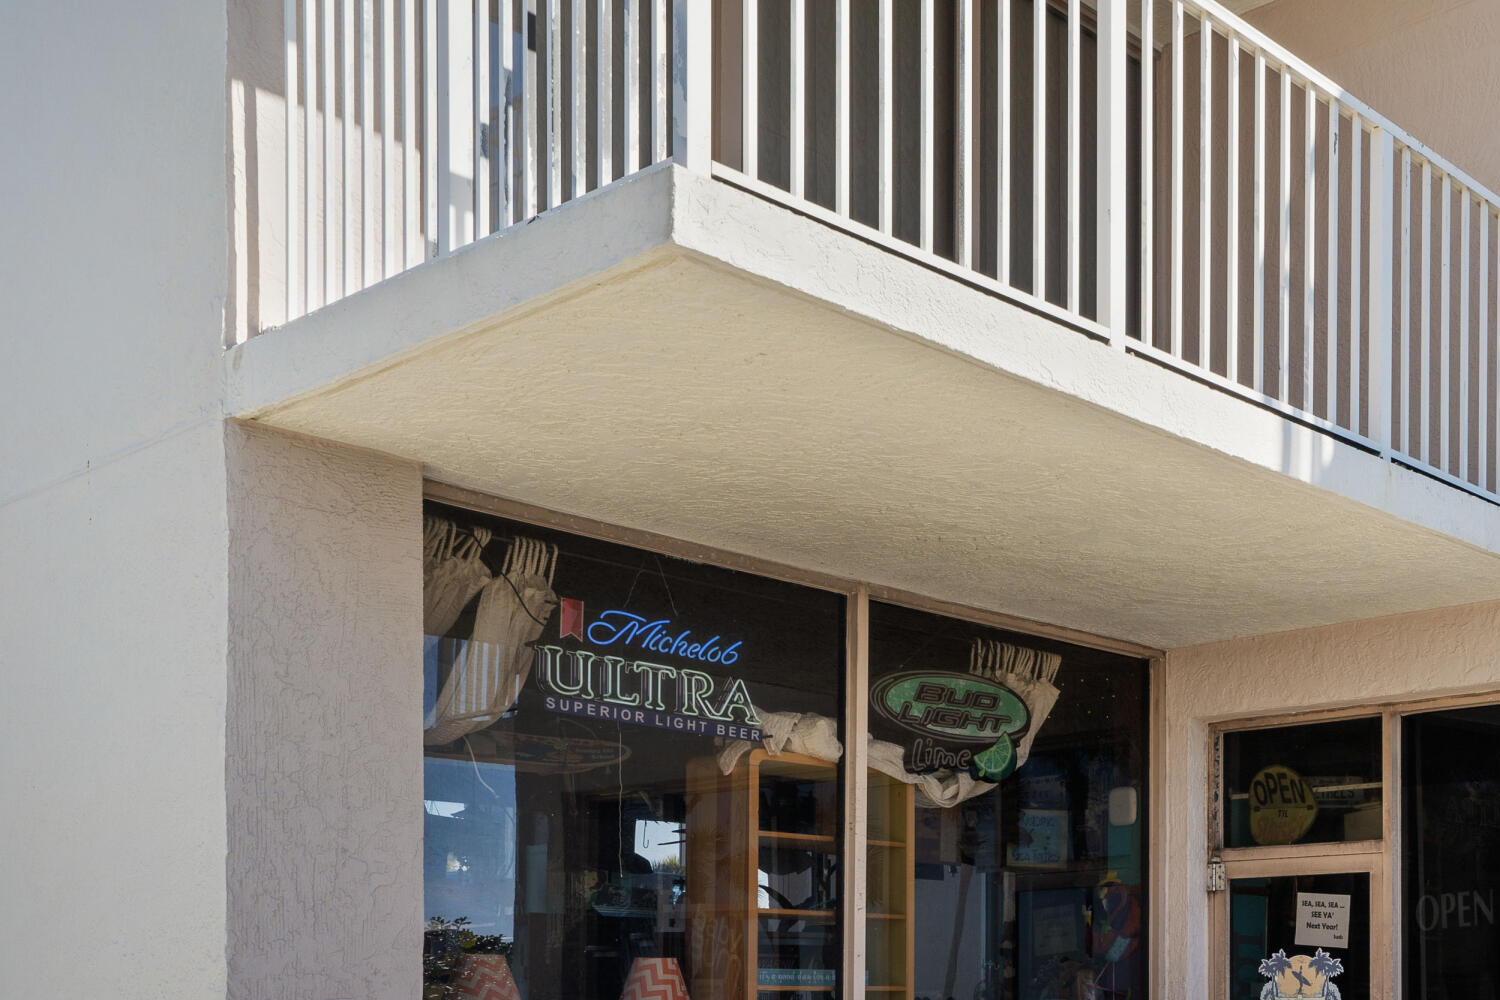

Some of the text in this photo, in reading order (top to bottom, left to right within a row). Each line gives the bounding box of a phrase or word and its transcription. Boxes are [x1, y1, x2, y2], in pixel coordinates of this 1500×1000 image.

[587, 610, 743, 665] Michelob
[538, 645, 762, 726] ULTRA
[912, 681, 1000, 712] BUD
[546, 698, 761, 741] SUPERIOR LIGHT BEER
[896, 702, 1013, 734] LIGHT
[911, 737, 972, 772] Lime
[1253, 772, 1307, 806] OPEN
[1415, 887, 1495, 932] OPEN
